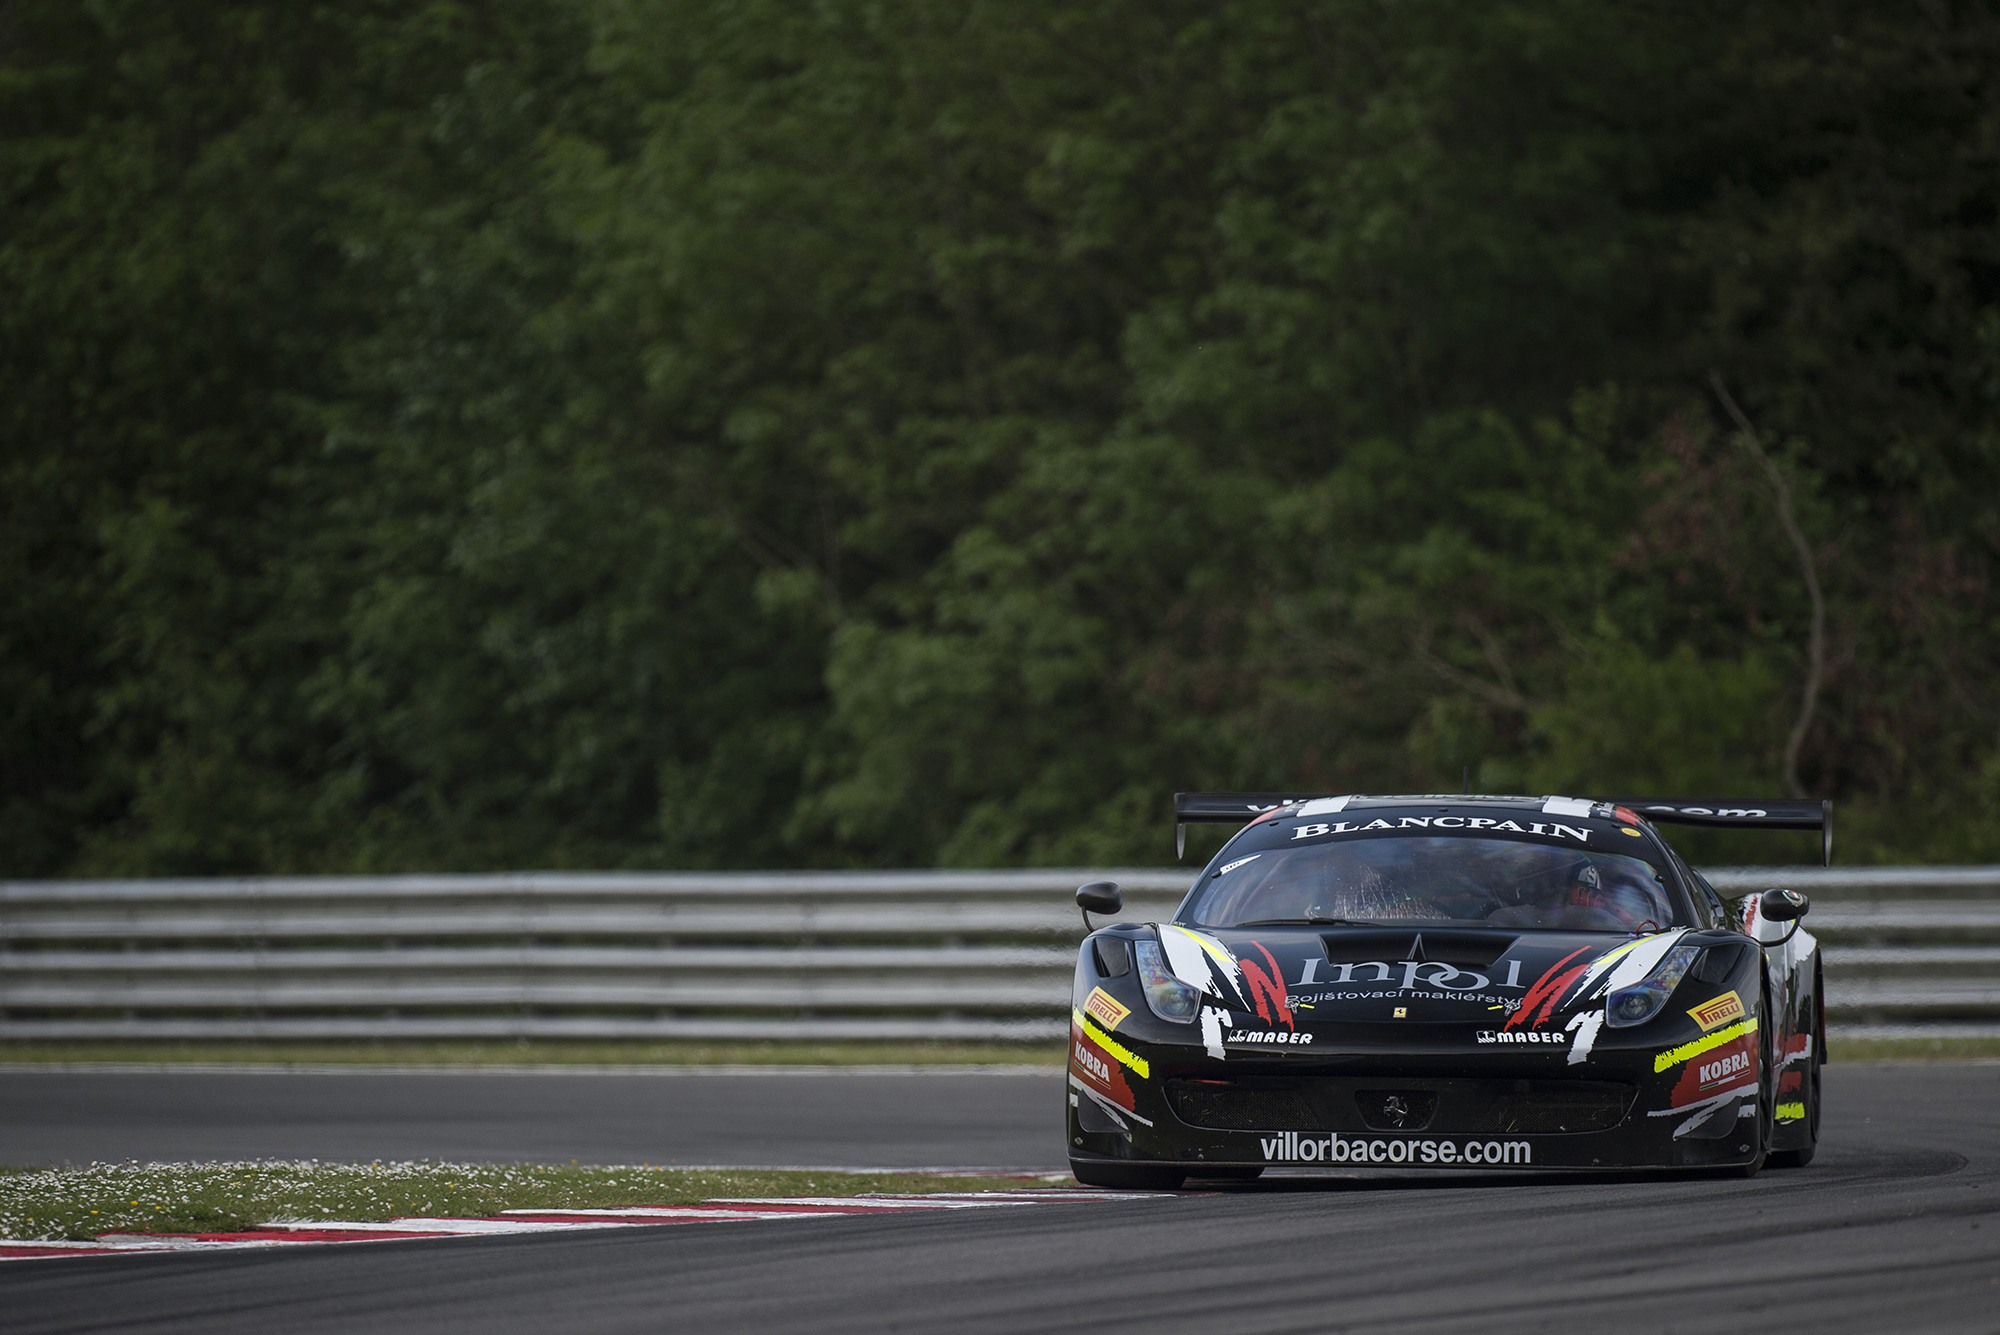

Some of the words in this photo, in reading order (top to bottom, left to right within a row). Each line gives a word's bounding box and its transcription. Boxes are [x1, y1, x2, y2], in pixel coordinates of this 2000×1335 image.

[1291, 816, 1593, 842] BLANCPAIN
[1288, 957, 1526, 991] Inpol
[1087, 991, 1122, 1024] PIRELLI
[1696, 996, 1741, 1025] PIRELLI
[1246, 1031, 1313, 1044] MABER
[1496, 1032, 1565, 1043] MABER
[1074, 1040, 1110, 1082] KOBRA
[1700, 1050, 1750, 1083] KOBRA
[1260, 1131, 1531, 1164] villorbacorse.com
